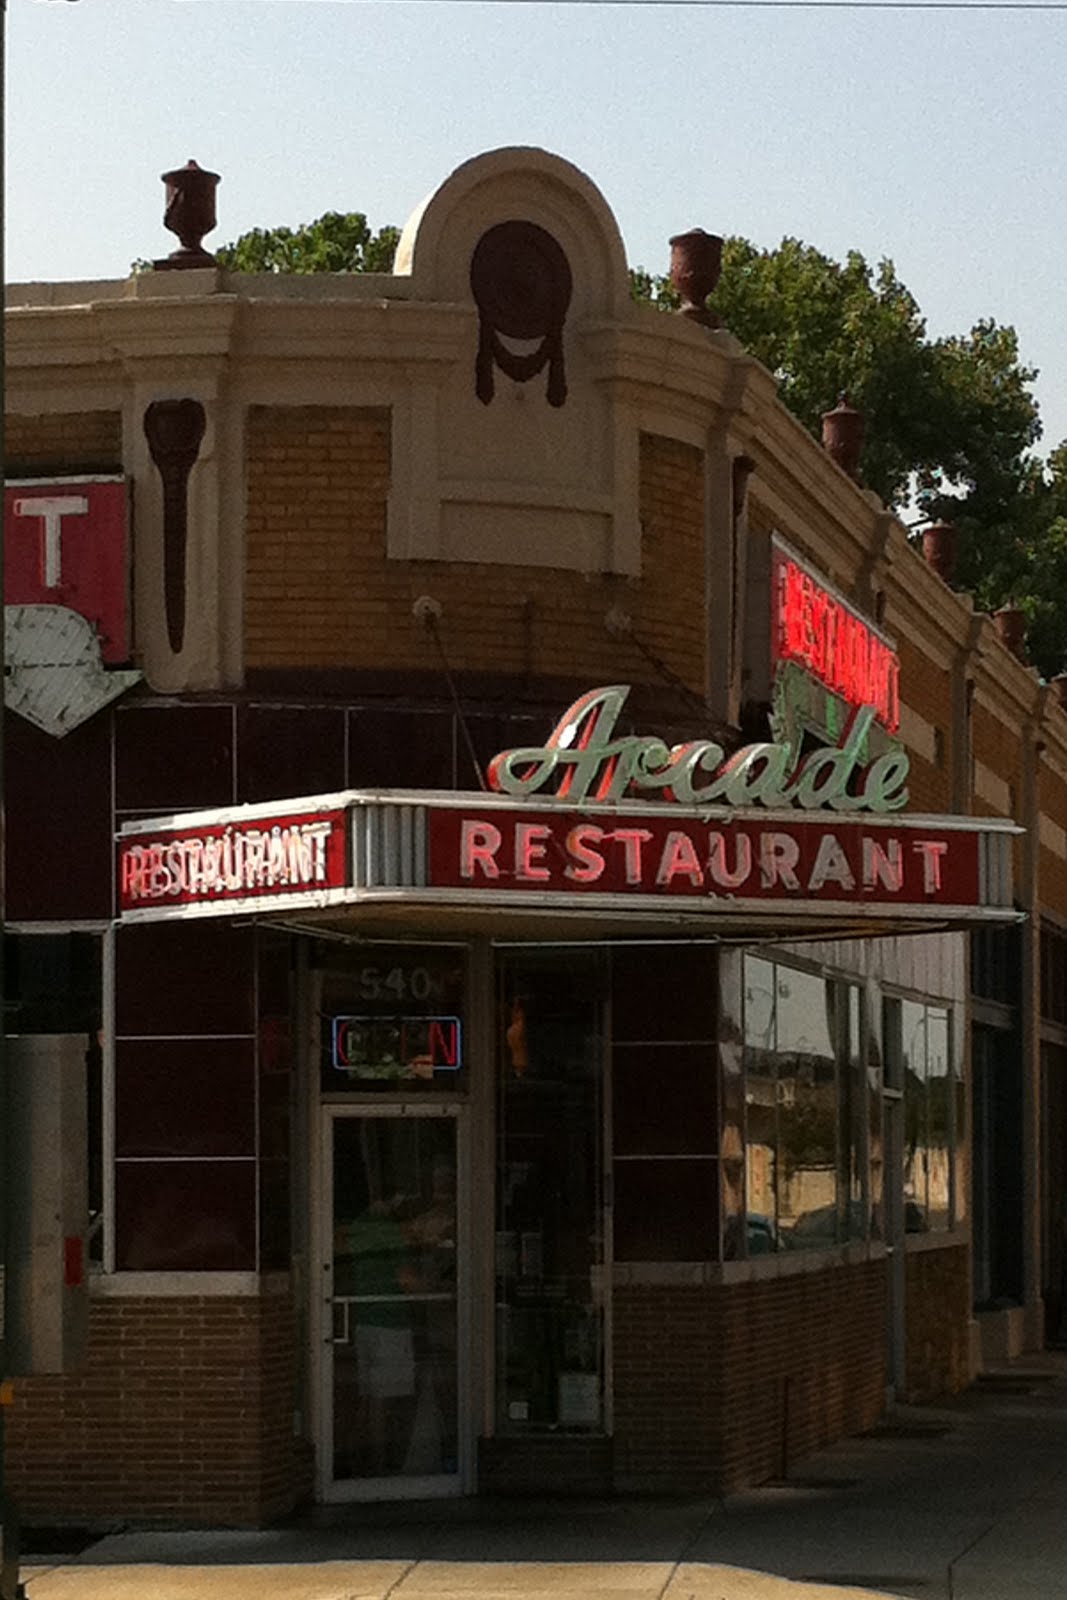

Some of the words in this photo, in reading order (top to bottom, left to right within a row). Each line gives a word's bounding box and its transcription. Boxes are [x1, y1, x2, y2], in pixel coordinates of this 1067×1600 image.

[488, 685, 911, 812] Arcade
[460, 819, 949, 893] RESTAURANT
[359, 967, 432, 1000] 540
